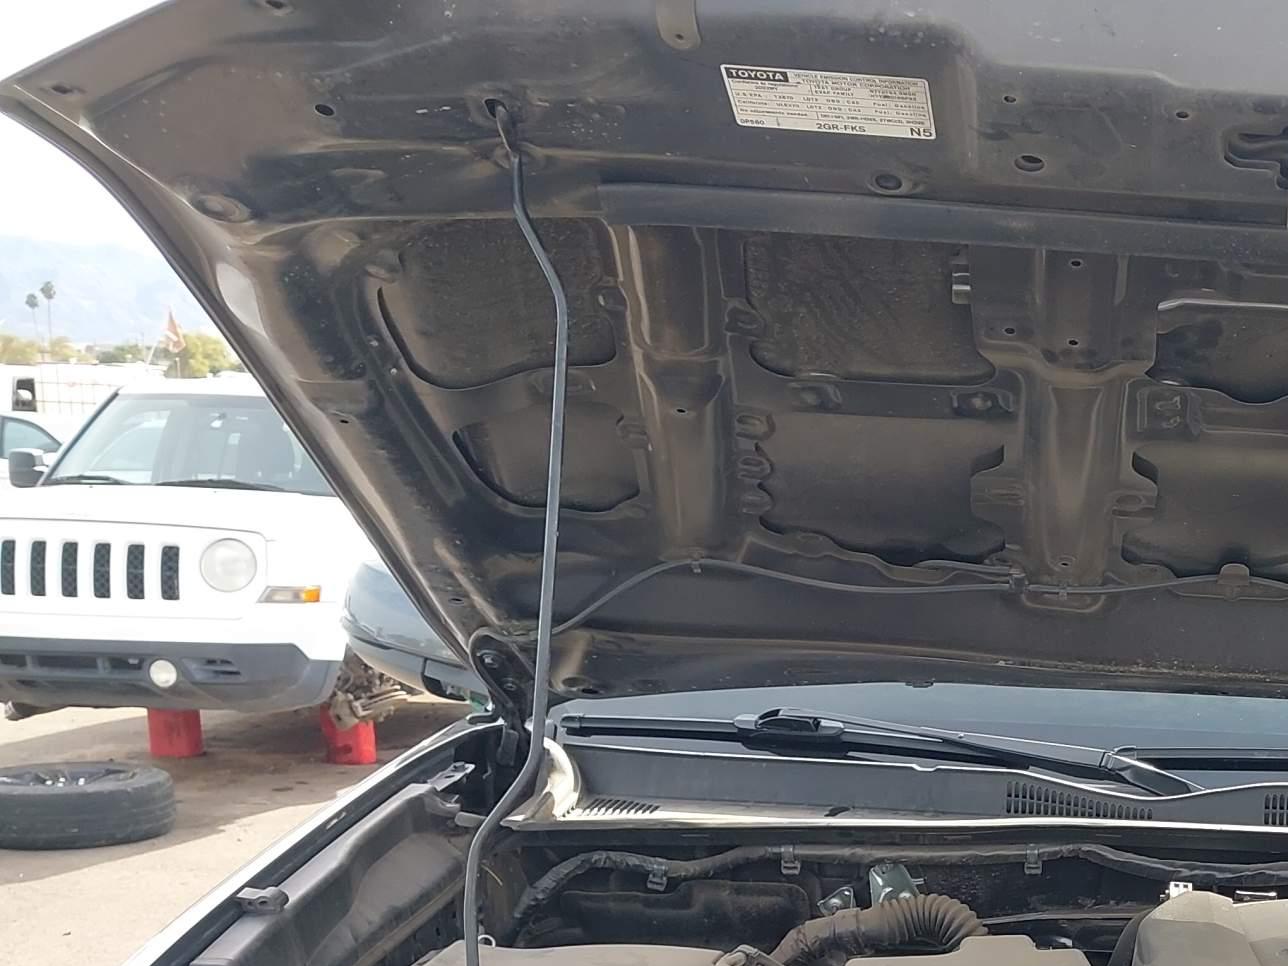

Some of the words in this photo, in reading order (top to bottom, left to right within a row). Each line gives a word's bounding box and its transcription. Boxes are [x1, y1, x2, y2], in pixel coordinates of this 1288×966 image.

[729, 69, 784, 81] TOYOTA
[815, 122, 866, 133] 2GR-FKS
[909, 126, 933, 138] N5
